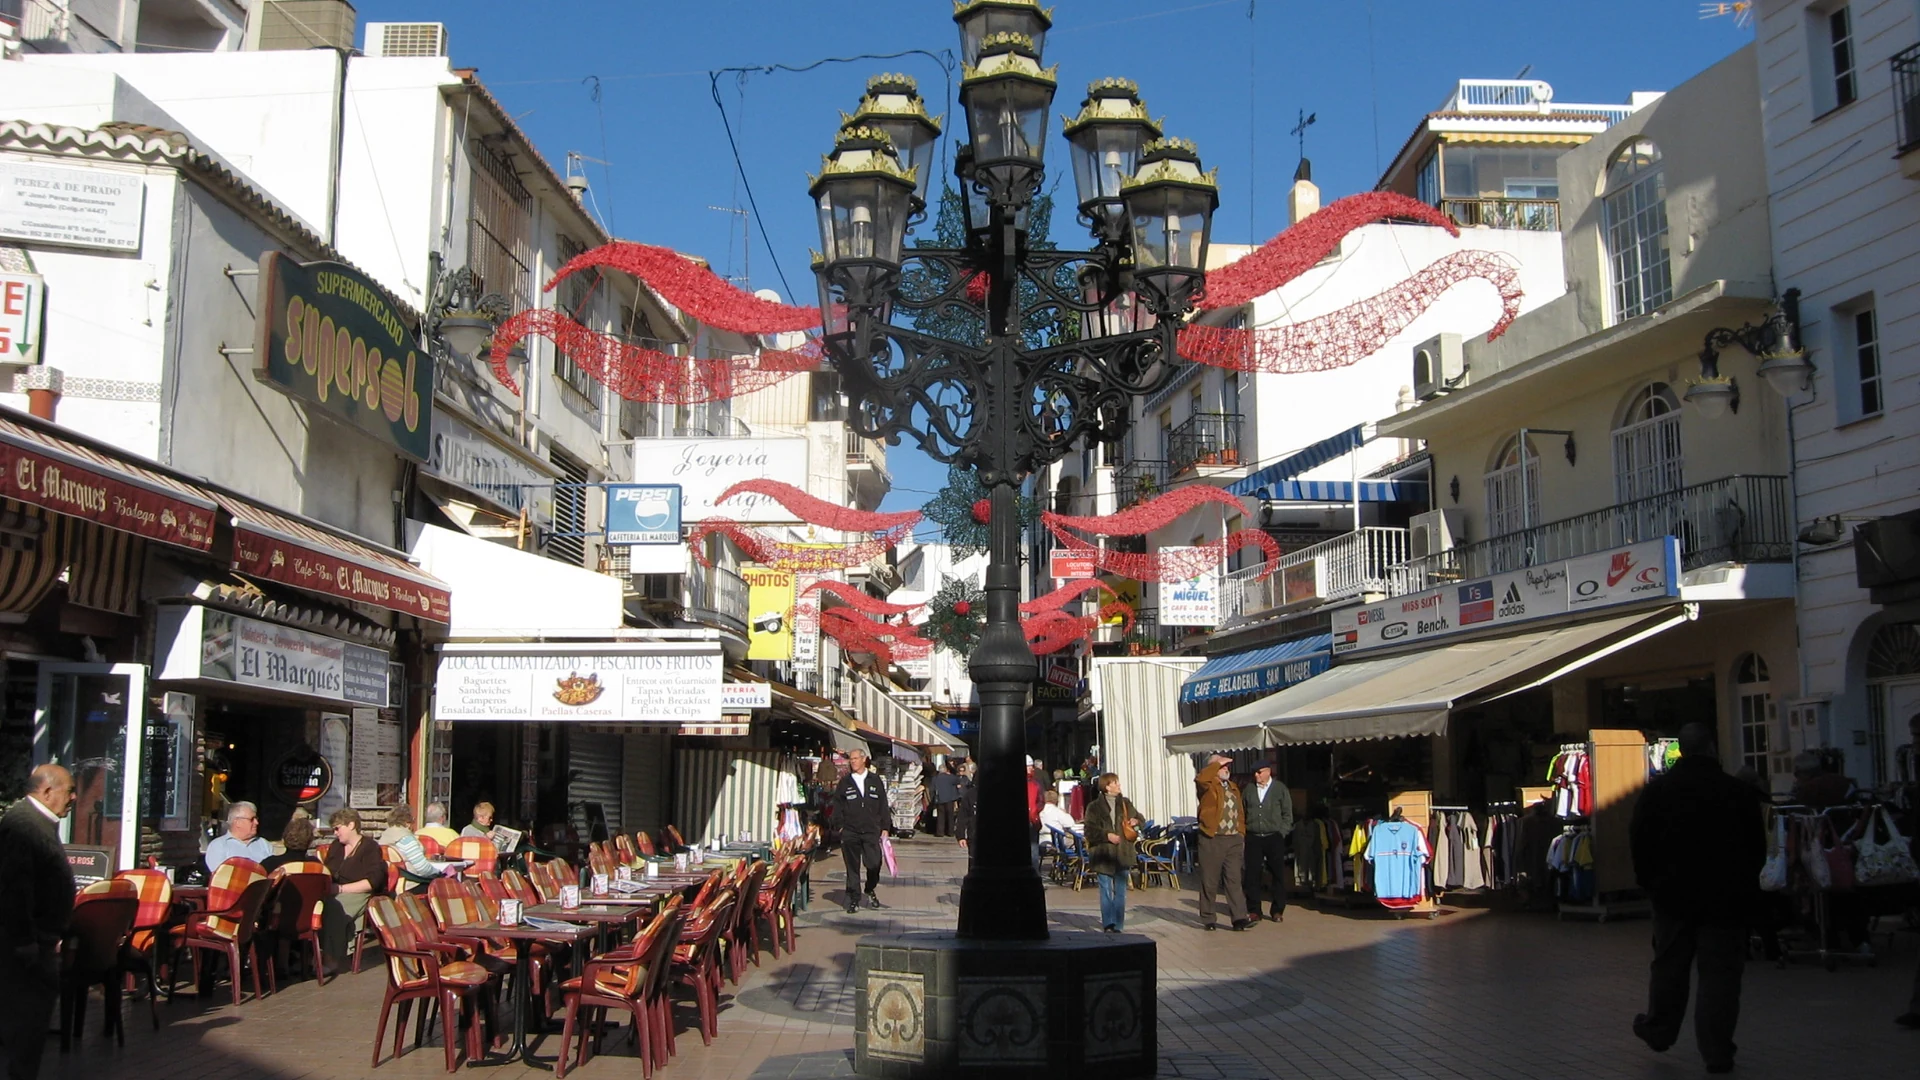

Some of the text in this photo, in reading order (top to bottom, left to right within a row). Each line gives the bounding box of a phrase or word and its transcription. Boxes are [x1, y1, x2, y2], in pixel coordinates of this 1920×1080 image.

[14, 177, 122, 197] PEREZ & DE PRADO
[317, 271, 404, 347] SUPERMERCADO
[672, 443, 768, 477] Joyería
[16, 457, 157, 526] El Marques Bodega
[615, 488, 673, 502] PEPSI
[609, 531, 640, 541] CAFETERIA
[641, 532, 648, 541] EL
[1611, 550, 1632, 572] NIKE
[336, 565, 351, 591] El
[352, 569, 390, 601] Marques
[742, 572, 790, 588] PHOTOS
[1194, 604, 1209, 612] BAR
[1402, 592, 1443, 613] MISS SIXTY
[1368, 606, 1386, 624] DIESEL
[1498, 602, 1525, 618] adidas
[1417, 616, 1449, 635] Bench.
[240, 645, 261, 678] El
[265, 650, 341, 693] Marqués
[447, 657, 488, 670] LOCAL
[491, 657, 582, 670] CLIMATIZADO
[592, 656, 662, 671] PESCAITOS
[666, 656, 713, 670] FRITOS
[463, 676, 507, 689] Baguettes
[626, 675, 717, 686] Entrecot con Guarnición
[1050, 669, 1078, 686] INTERN
[1194, 681, 1211, 698] CAFE
[1218, 673, 1260, 694] HELADERIA
[1265, 669, 1281, 686] SAN
[1284, 660, 1312, 684] MIGUEL
[458, 685, 511, 695] Sandwiches
[637, 686, 706, 697] Tapas Variadas
[1037, 686, 1070, 698] FACTO
[461, 695, 507, 707] Camperos
[631, 696, 711, 708] English Breakfast
[721, 695, 766, 705] ARQUÉS
[441, 705, 527, 715] Ensaladas Variadas
[541, 706, 613, 716] Paellas Caseras
[640, 706, 702, 718] Fish & Chips
[282, 762, 321, 776] Estrella
[283, 774, 319, 787] Galicia
[77, 856, 96, 866] ROSÉ
